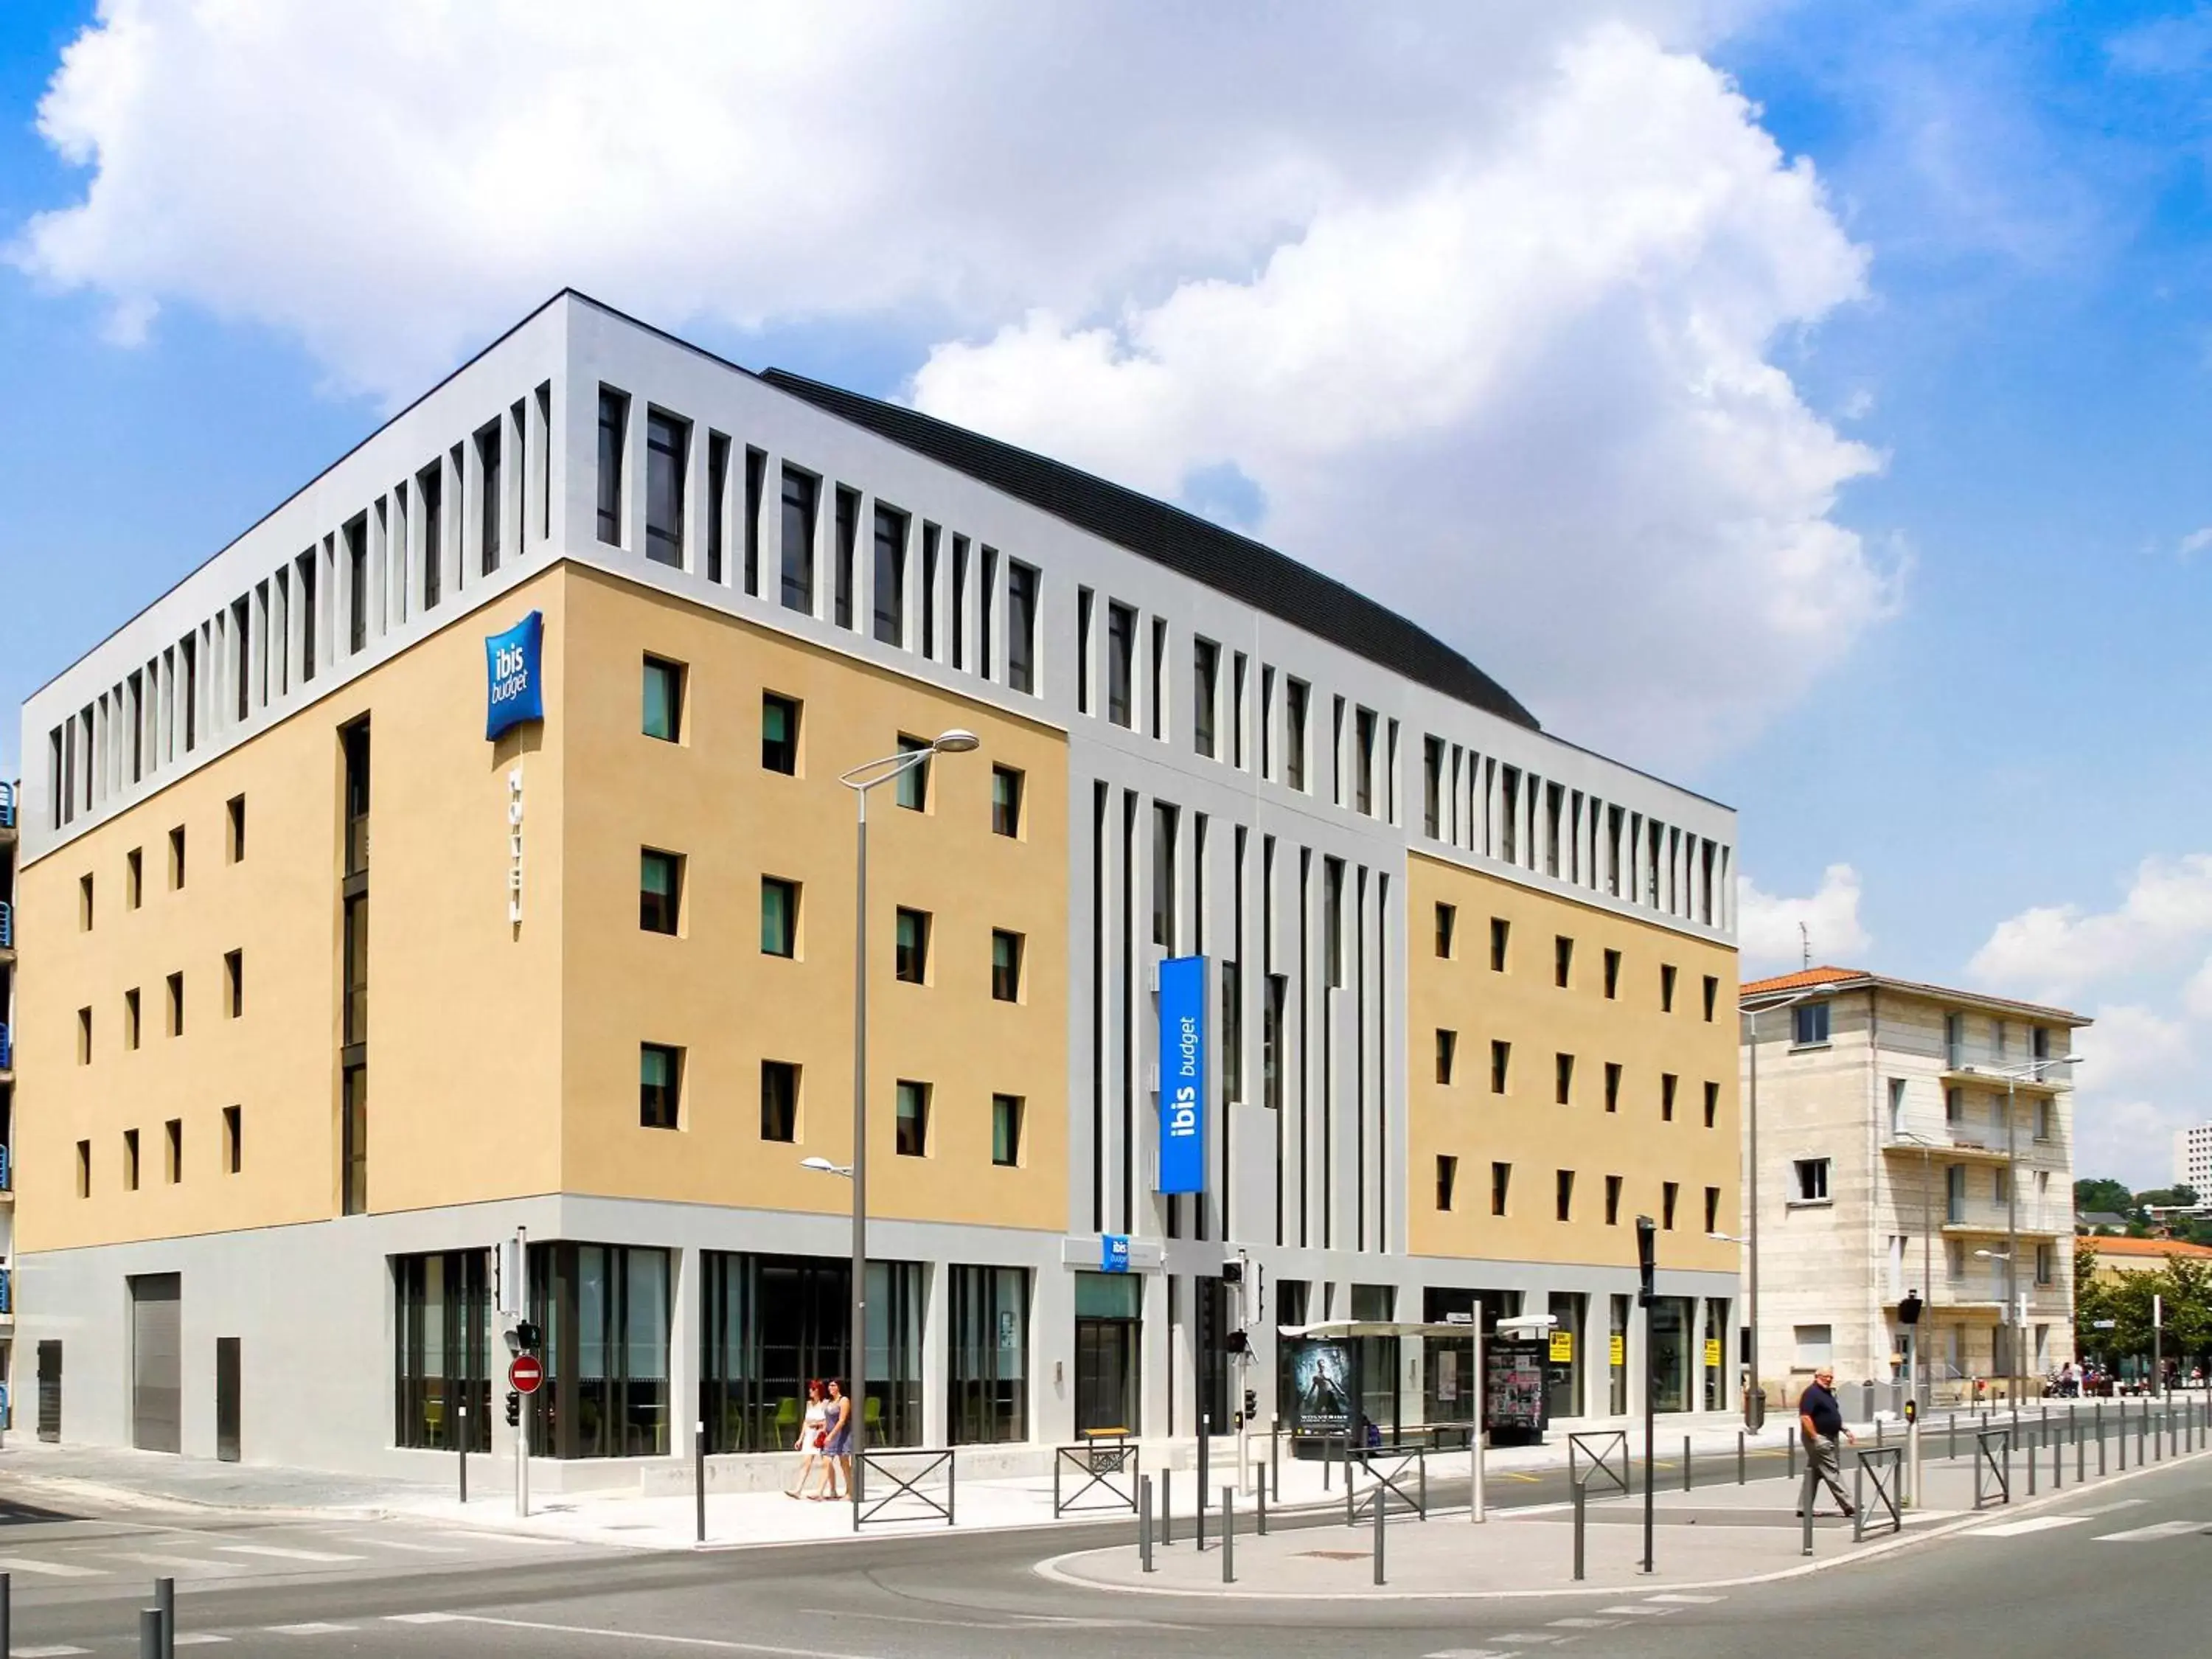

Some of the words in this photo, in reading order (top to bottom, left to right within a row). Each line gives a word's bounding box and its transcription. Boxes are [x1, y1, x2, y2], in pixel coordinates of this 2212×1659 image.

[496, 642, 524, 681] ibis
[492, 668, 528, 704] budget
[1180, 1016, 1198, 1077] budget
[1170, 1086, 1195, 1136] ibis
